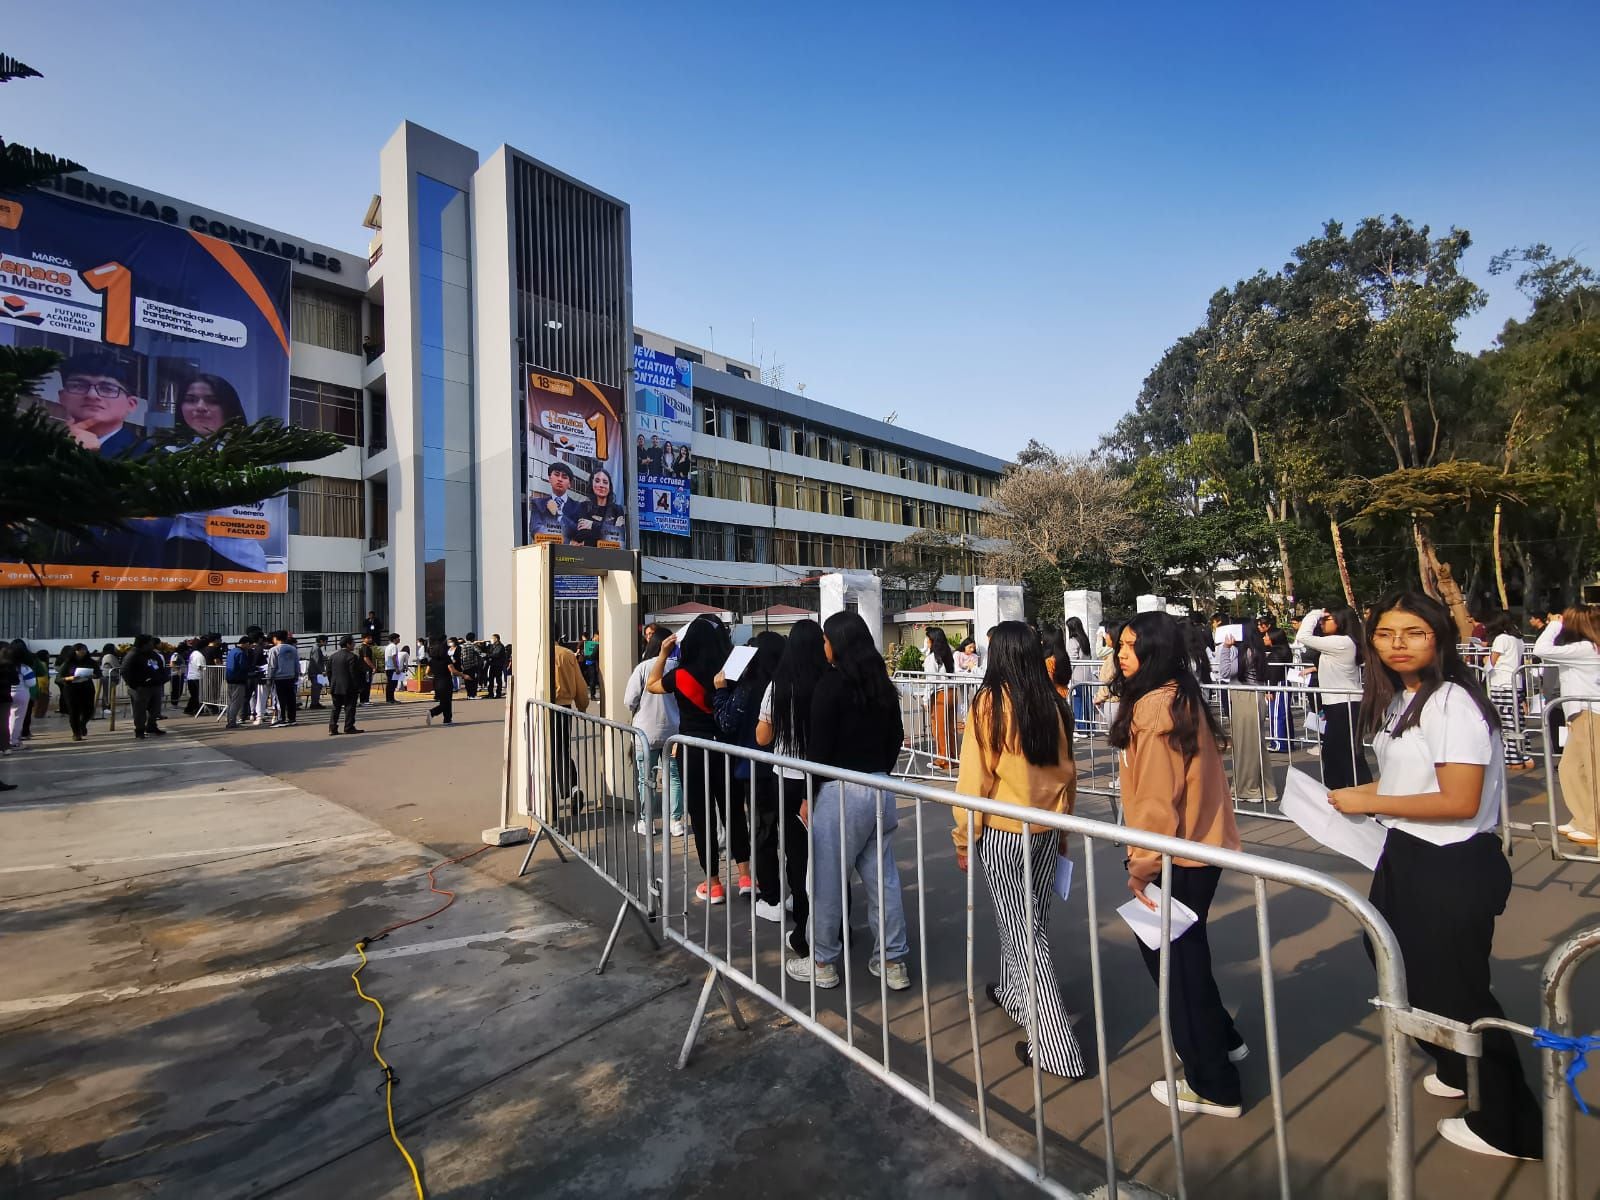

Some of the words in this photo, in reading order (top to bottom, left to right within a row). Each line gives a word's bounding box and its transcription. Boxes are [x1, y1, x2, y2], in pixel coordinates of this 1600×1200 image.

[189, 214, 342, 274] CONTABLES
[32, 252, 72, 267] MARCA:
[12, 275, 72, 297] Marcos
[82, 261, 132, 346] 1
[54, 307, 88, 320] FUTURO
[197, 316, 214, 324] que
[49, 320, 91, 334] CONTABLE
[143, 317, 197, 334] compromiso
[537, 375, 550, 388] 18
[634, 371, 677, 389] ONTABLE
[586, 412, 608, 460] 1
[233, 509, 265, 517] Guerrero
[220, 521, 255, 529] CONSEJO
[228, 527, 266, 536] FACULTAD
